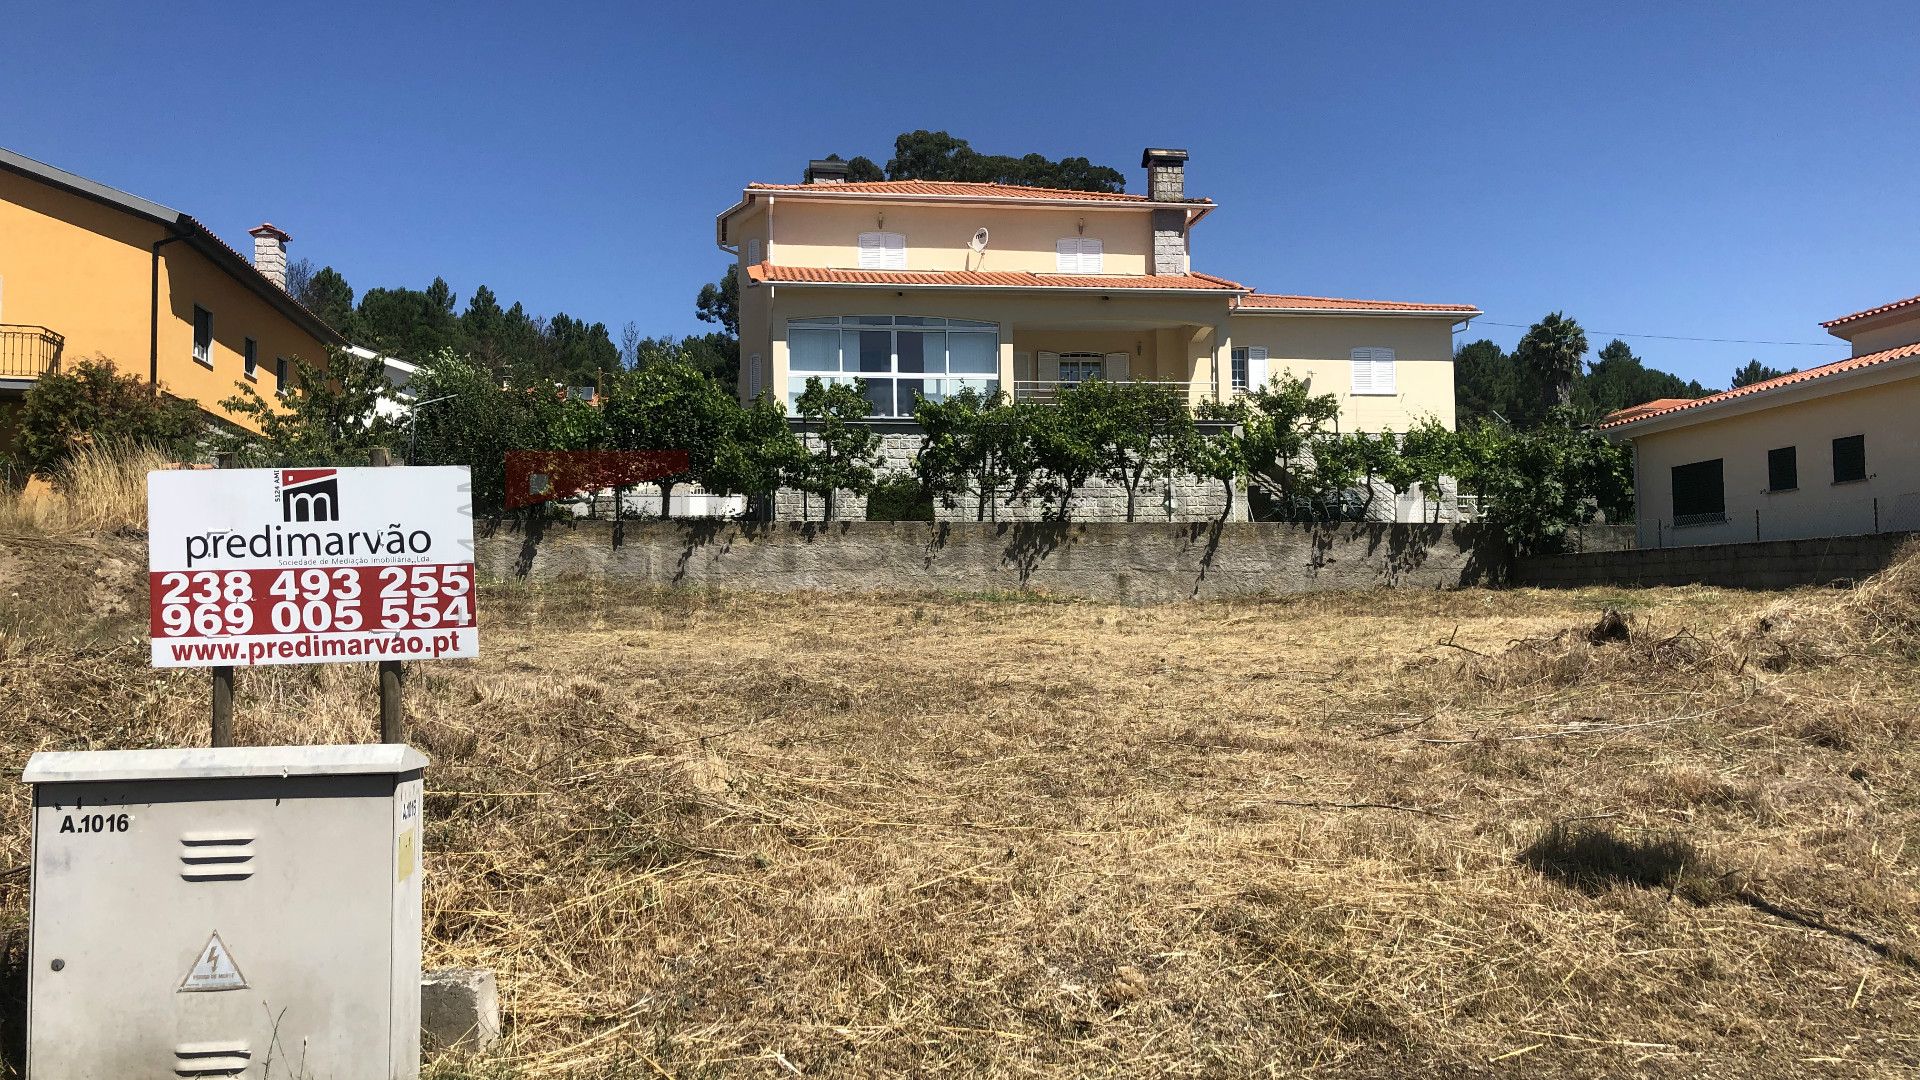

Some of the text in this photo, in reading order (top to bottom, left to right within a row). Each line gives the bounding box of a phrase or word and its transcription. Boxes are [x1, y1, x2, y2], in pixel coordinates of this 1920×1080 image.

[186, 523, 432, 568] predimarvão
[278, 558, 317, 566] Sociedade
[332, 557, 369, 566] Mediação
[161, 566, 470, 604] 238 493 255
[161, 596, 473, 637] 969 005 554
[59, 813, 130, 834] A.1016
